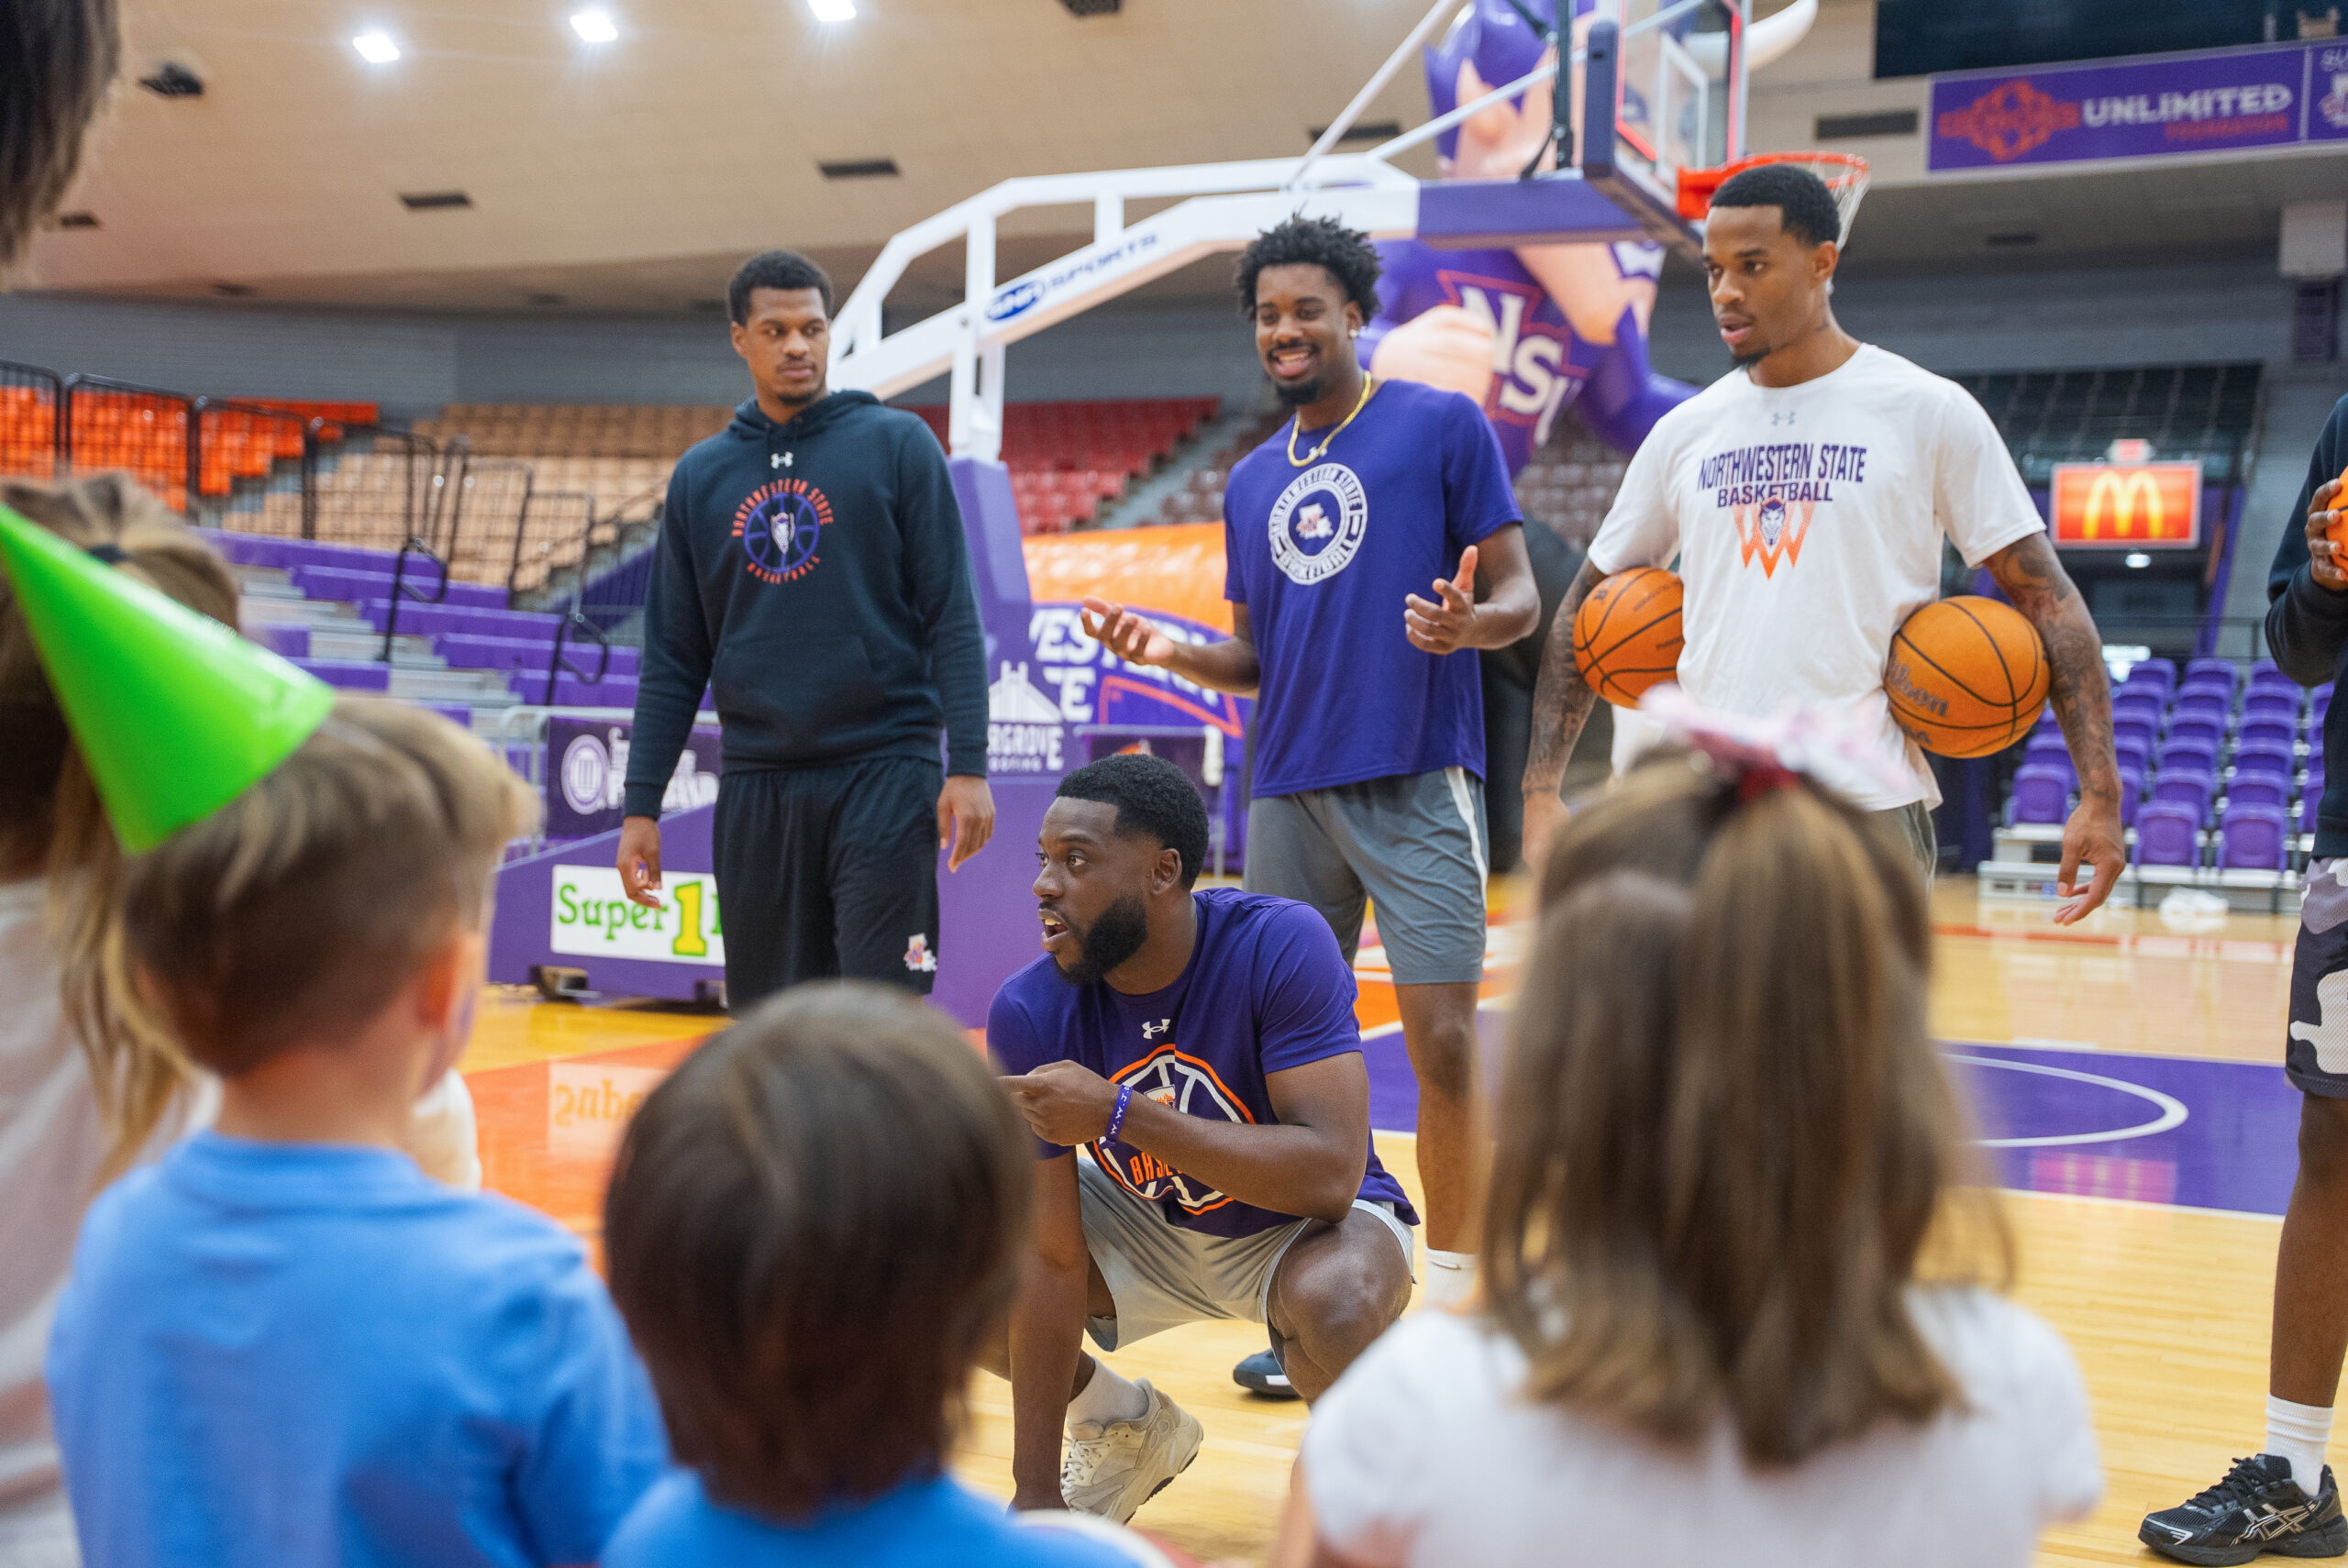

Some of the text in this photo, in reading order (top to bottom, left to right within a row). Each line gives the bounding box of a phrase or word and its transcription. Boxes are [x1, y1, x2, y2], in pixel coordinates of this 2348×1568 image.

[2082, 83, 2293, 128] UNLIMITED
[1697, 443, 1867, 492] NORTHWESTERN STATE
[1717, 481, 1833, 508] BASKETBALL
[557, 882, 669, 941] Super
[671, 880, 707, 958] 1
